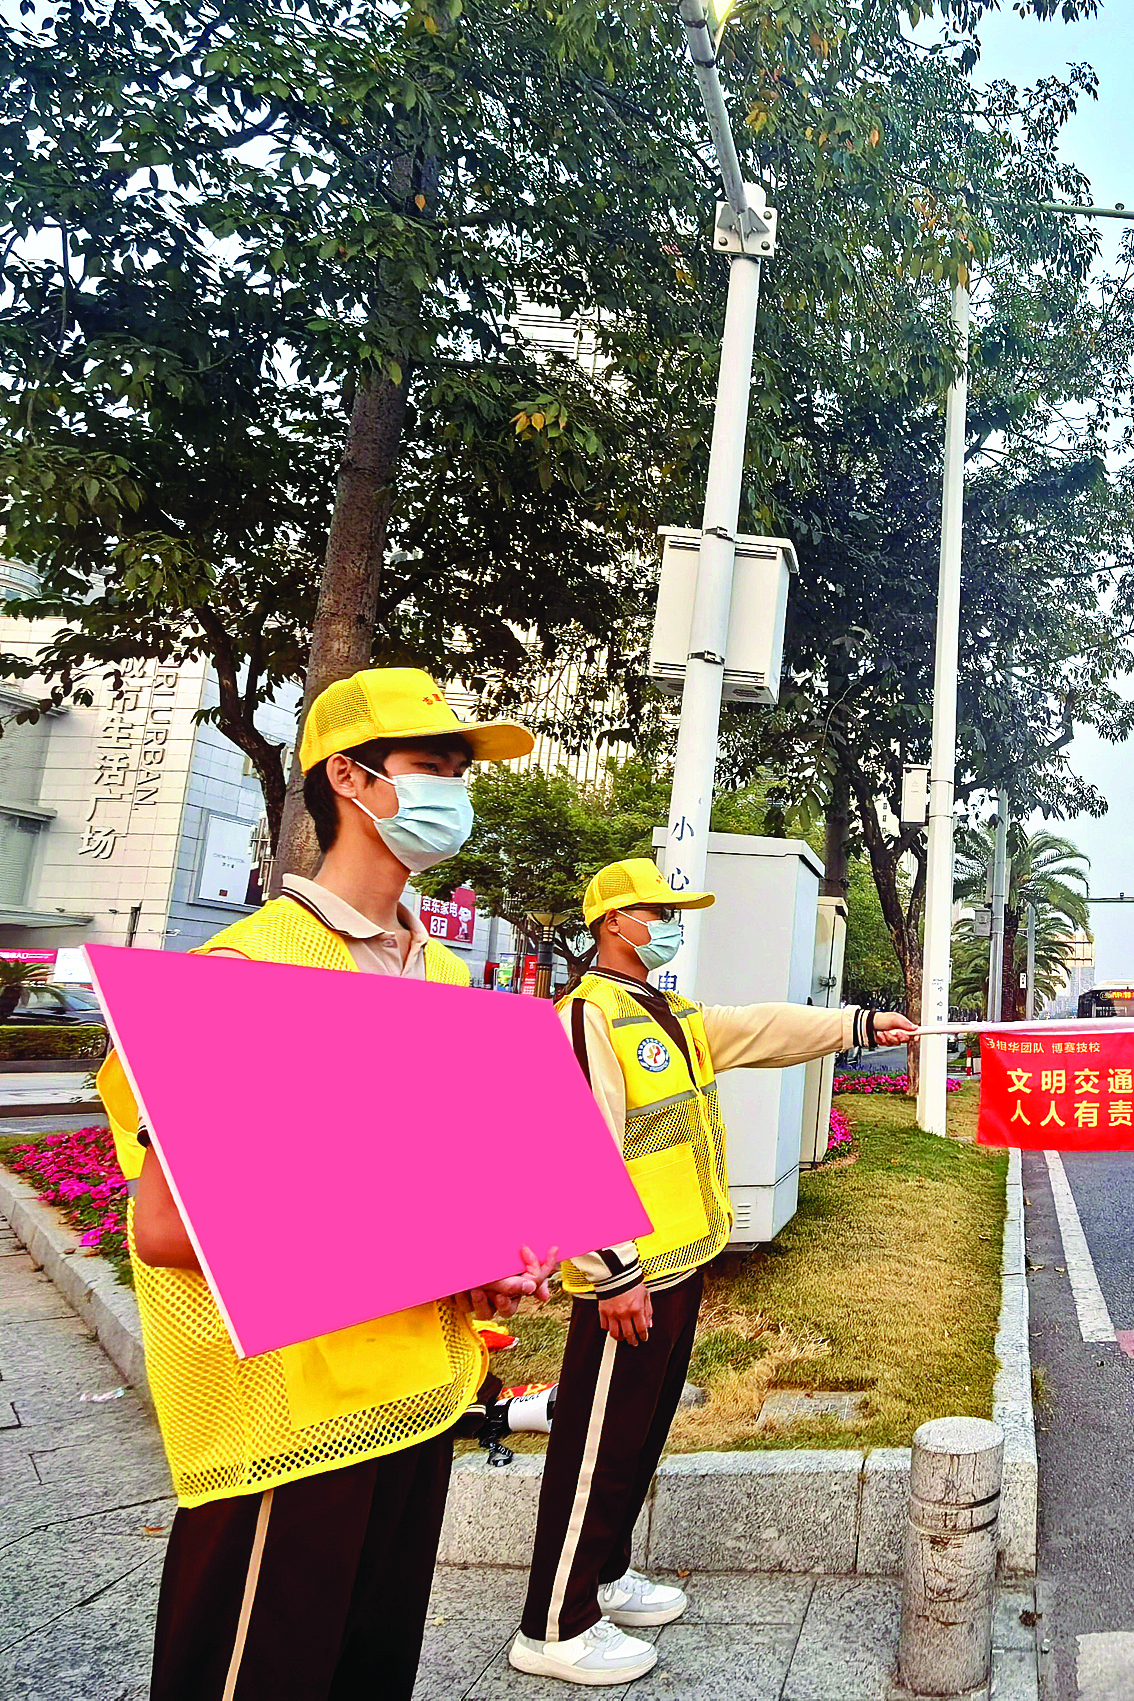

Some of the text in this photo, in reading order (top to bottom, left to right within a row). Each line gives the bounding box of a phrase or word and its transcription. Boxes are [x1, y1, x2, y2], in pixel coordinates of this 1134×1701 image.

[421, 895, 458, 918] 京东家电
[658, 815, 695, 994] 小心电
[432, 918, 446, 934] 3F
[996, 1039, 1101, 1054] 相华团队 博赛技校
[1006, 1068, 1134, 1094] 文明交通
[1010, 1099, 1134, 1128] 人人有责
